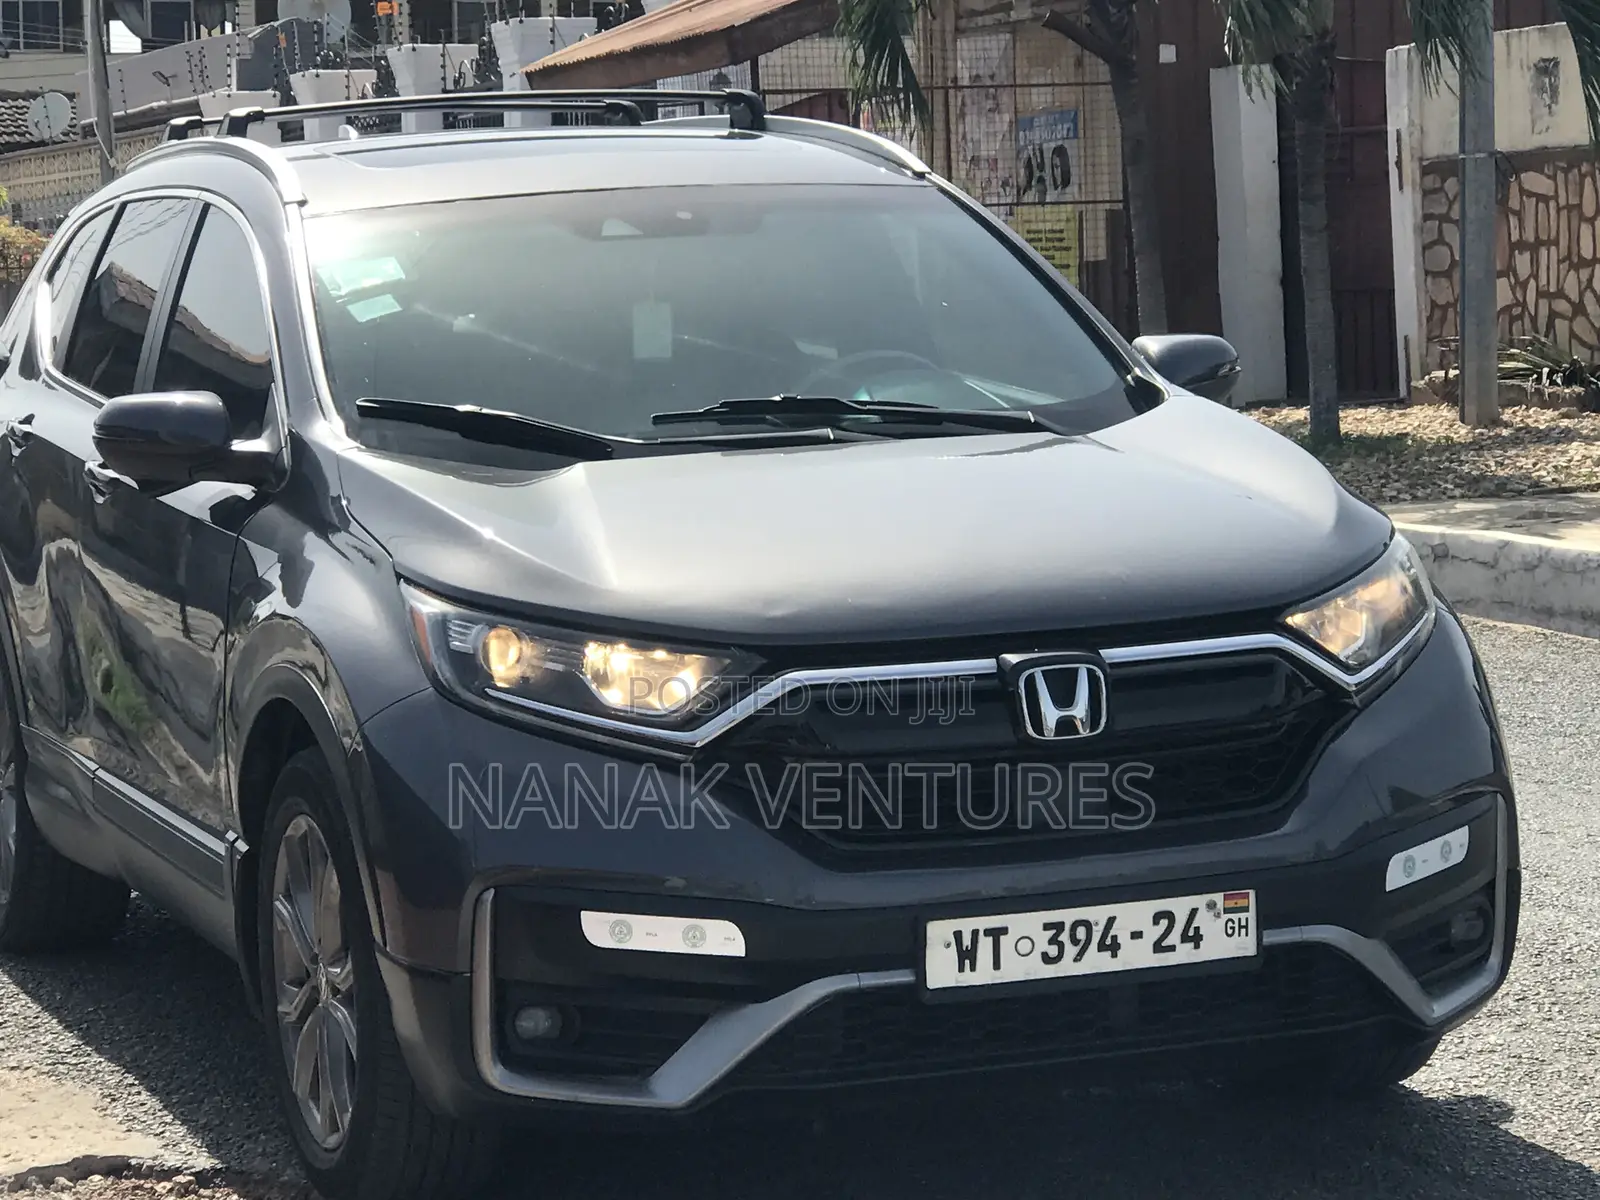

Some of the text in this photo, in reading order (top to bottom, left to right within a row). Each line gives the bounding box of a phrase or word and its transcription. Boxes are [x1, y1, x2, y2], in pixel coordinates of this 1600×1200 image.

[952, 907, 1204, 974] WT 394-24
[1224, 917, 1249, 938] GH
